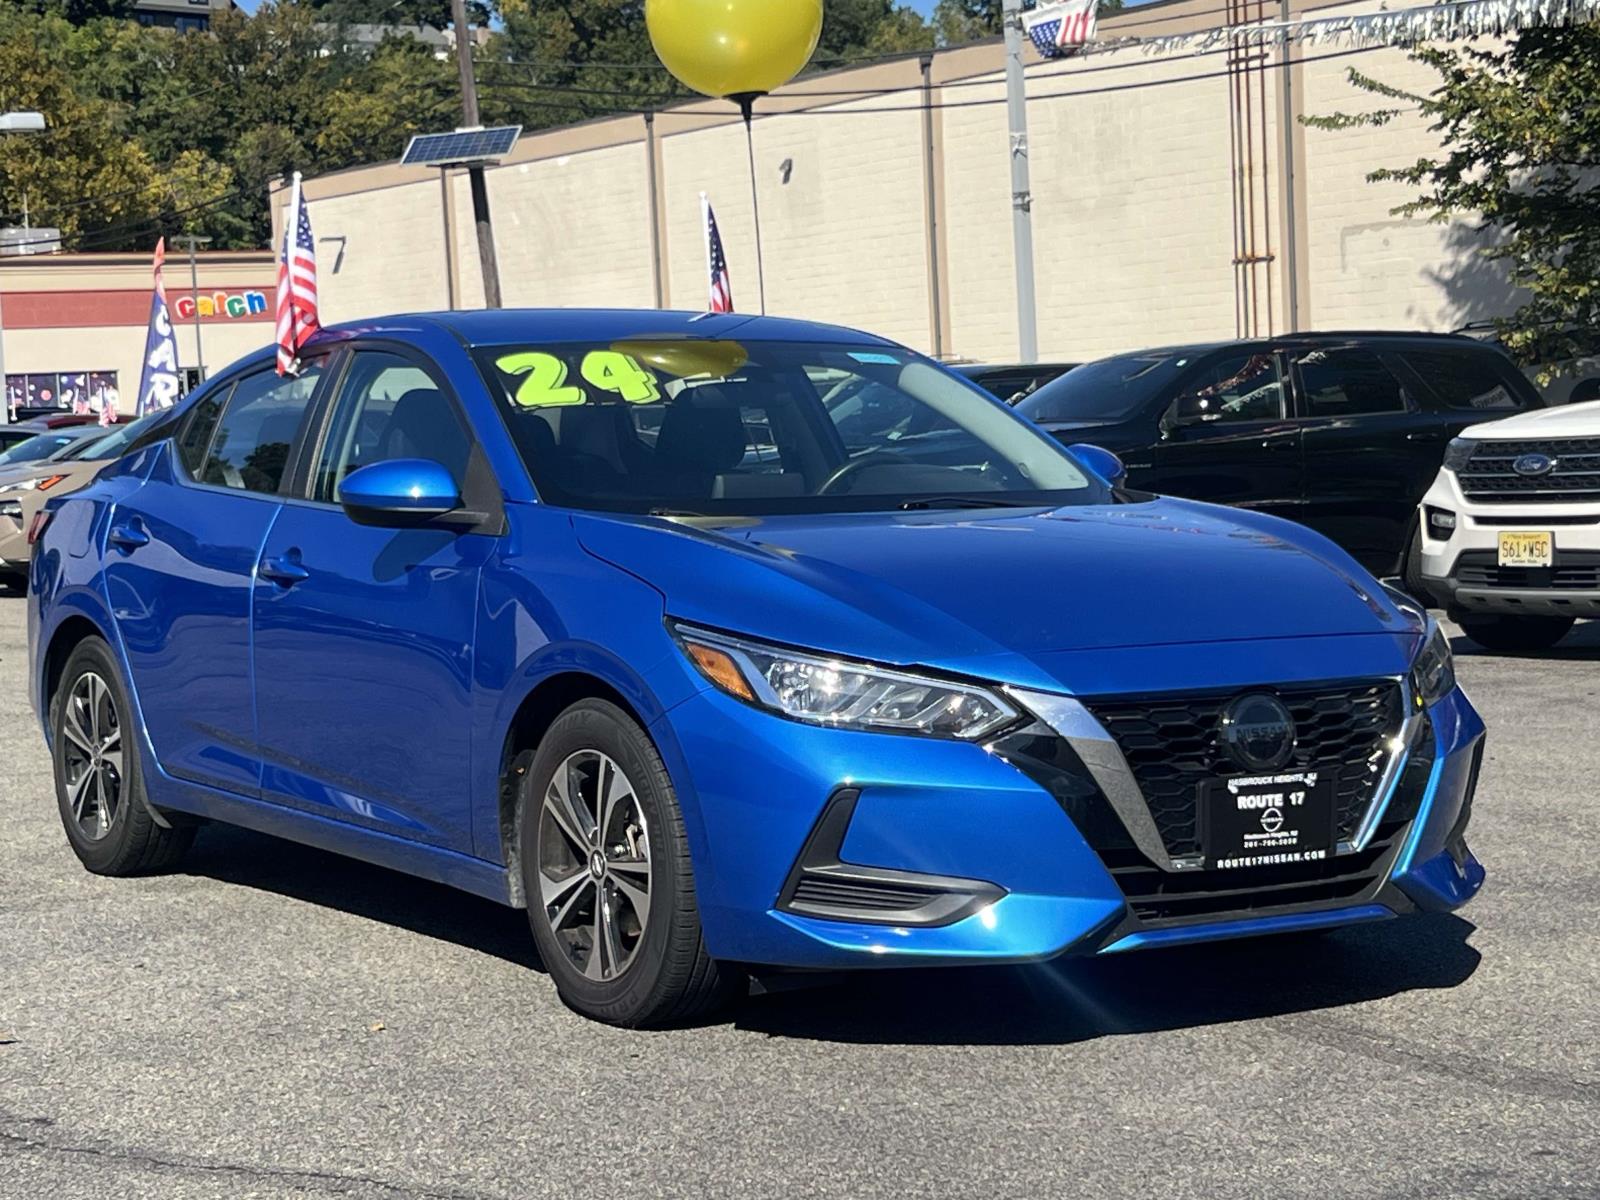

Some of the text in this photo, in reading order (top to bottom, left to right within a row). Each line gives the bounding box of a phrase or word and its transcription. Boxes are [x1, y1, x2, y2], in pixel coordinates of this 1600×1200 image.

[496, 351, 661, 411] 24
[1237, 791, 1305, 810] ROUTE 17
[1217, 850, 1326, 869] ROUTE17NISSAN.COM
